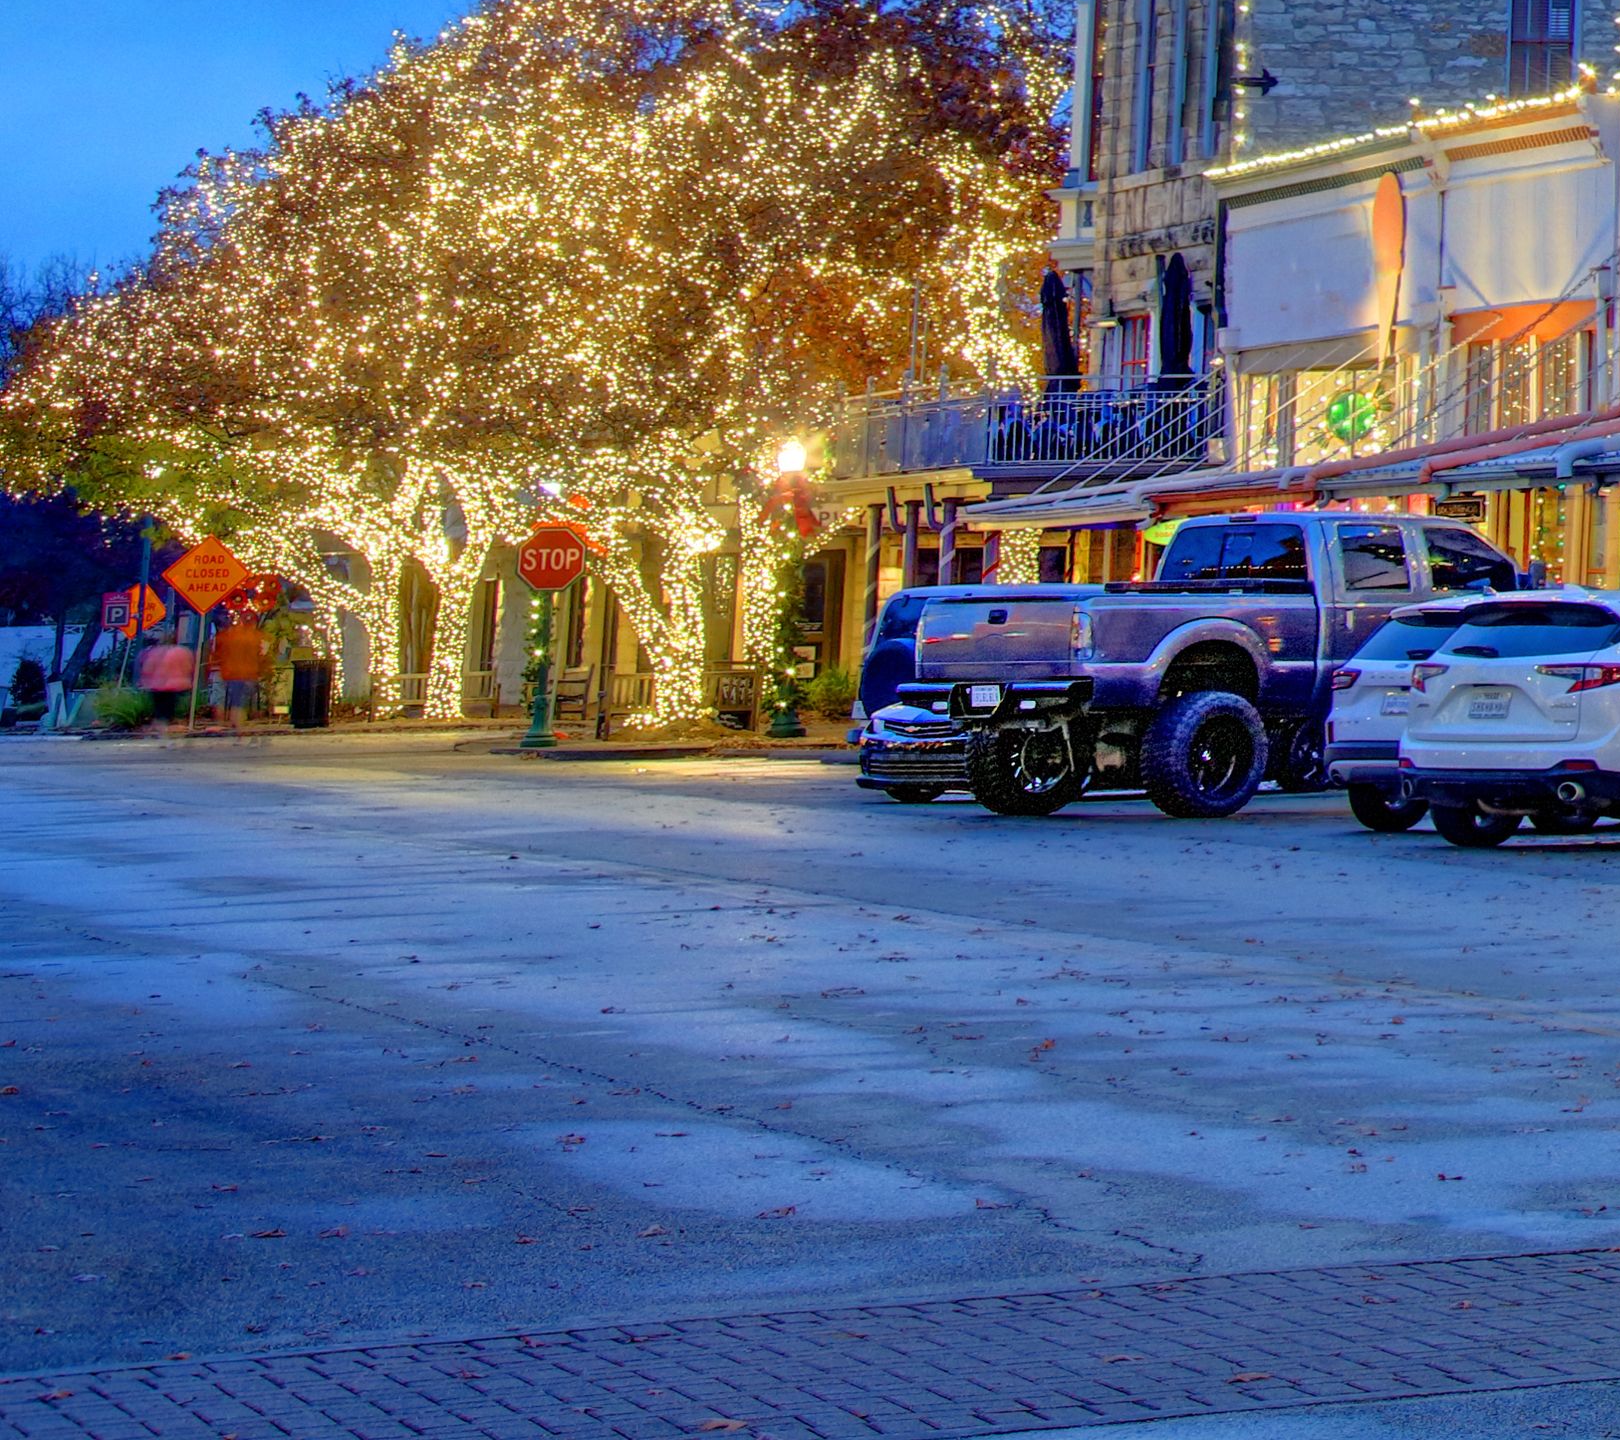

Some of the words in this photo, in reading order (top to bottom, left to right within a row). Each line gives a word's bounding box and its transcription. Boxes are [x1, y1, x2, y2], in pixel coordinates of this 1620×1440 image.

[193, 555, 225, 564] ROAD
[522, 548, 580, 571] STOP
[185, 568, 230, 579] CLOSED
[187, 583, 228, 593] AHEAD
